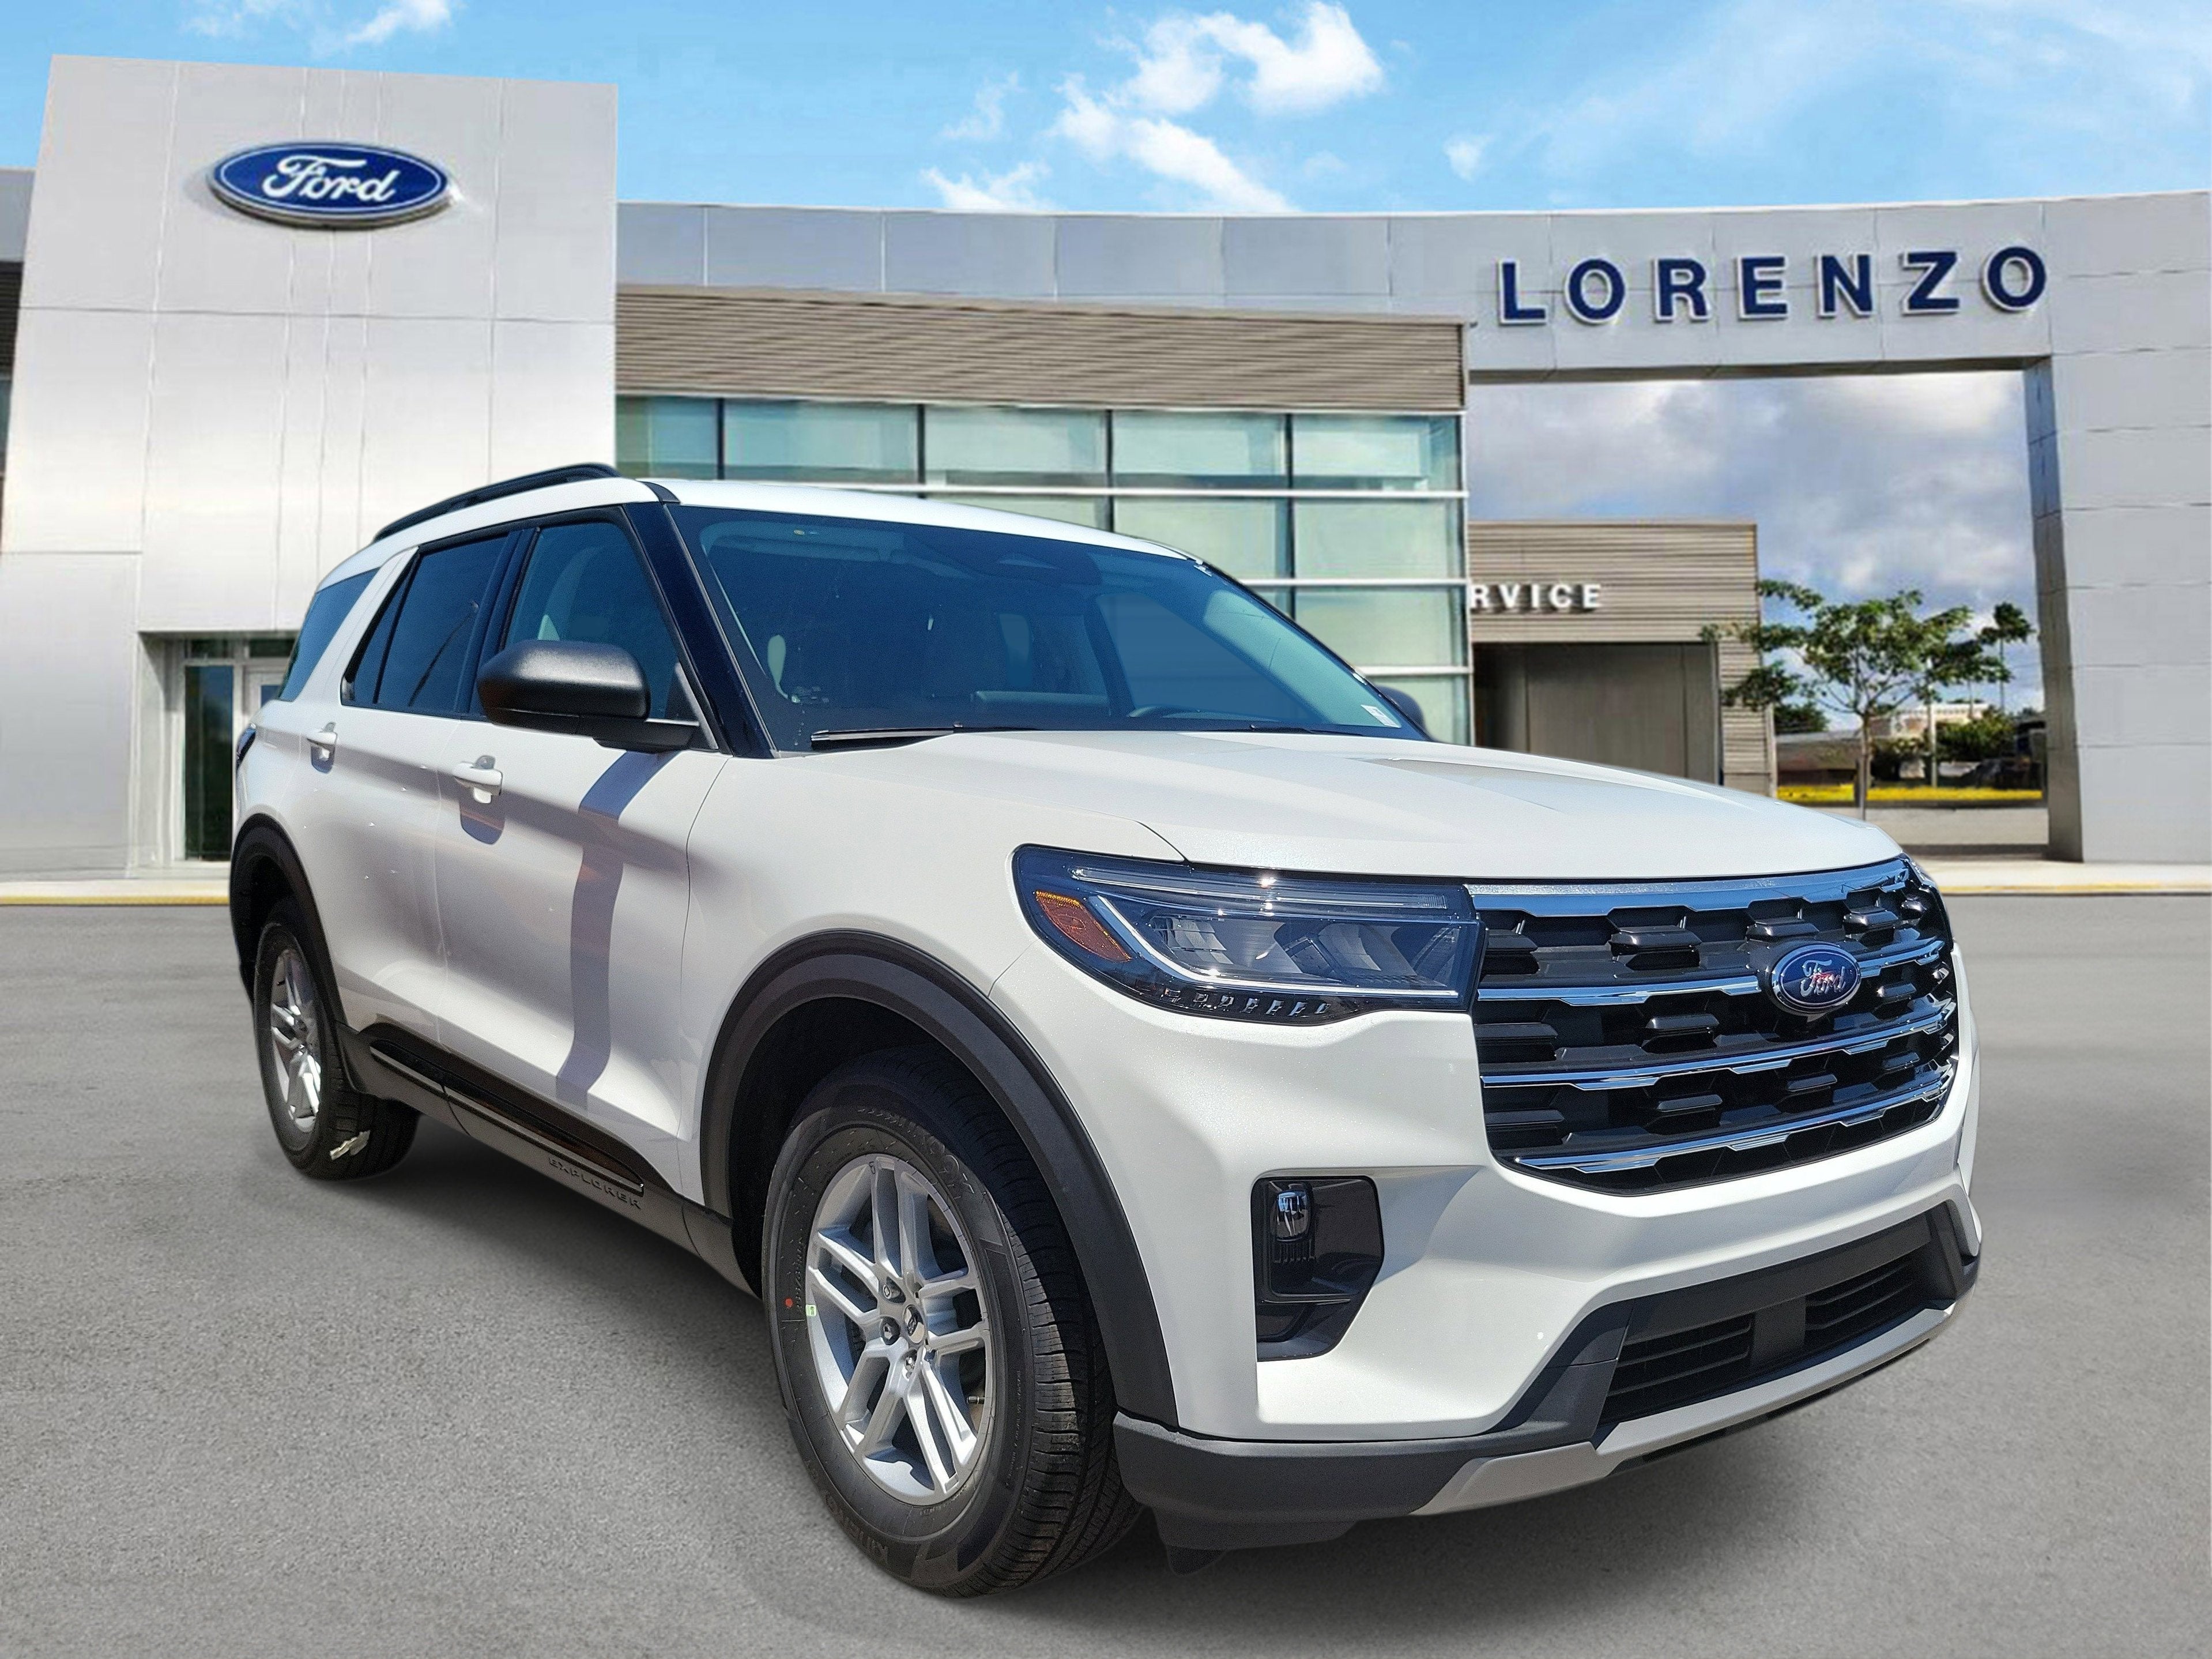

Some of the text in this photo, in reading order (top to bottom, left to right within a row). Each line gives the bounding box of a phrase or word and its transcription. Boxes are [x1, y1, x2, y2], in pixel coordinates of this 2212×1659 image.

[262, 155, 401, 202] Ford
[1497, 246, 2047, 324] LORENZO
[1800, 960, 1846, 998] Ford
